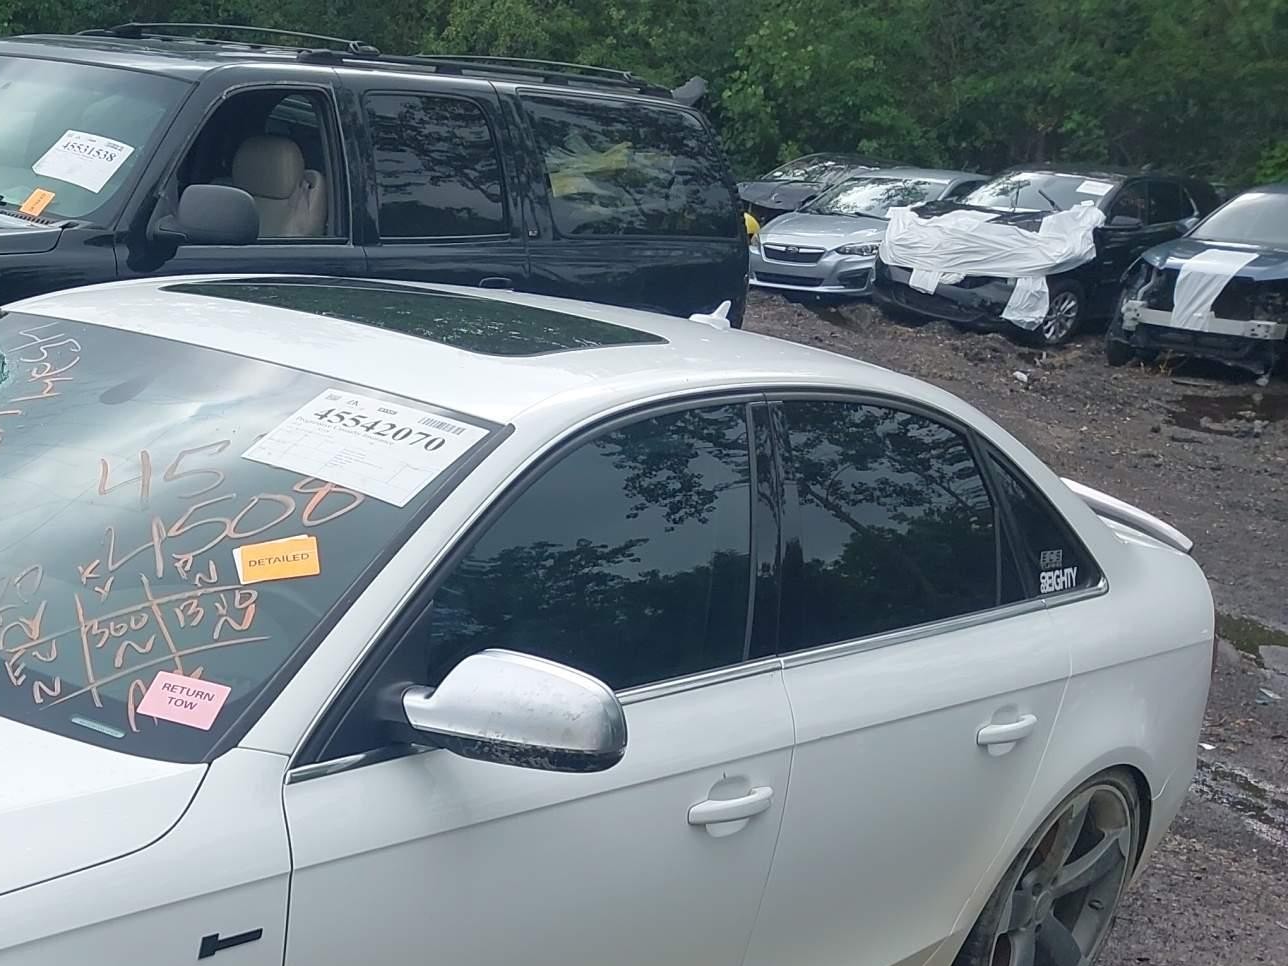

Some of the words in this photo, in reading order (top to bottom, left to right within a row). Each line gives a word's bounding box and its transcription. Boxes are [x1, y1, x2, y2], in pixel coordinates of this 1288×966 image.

[62, 141, 117, 162] 45531538
[313, 407, 447, 452] 45542070
[98, 440, 231, 508] 45
[248, 552, 310, 568] DETAILED
[162, 682, 216, 702] RETURN
[166, 696, 198, 712] TOW
